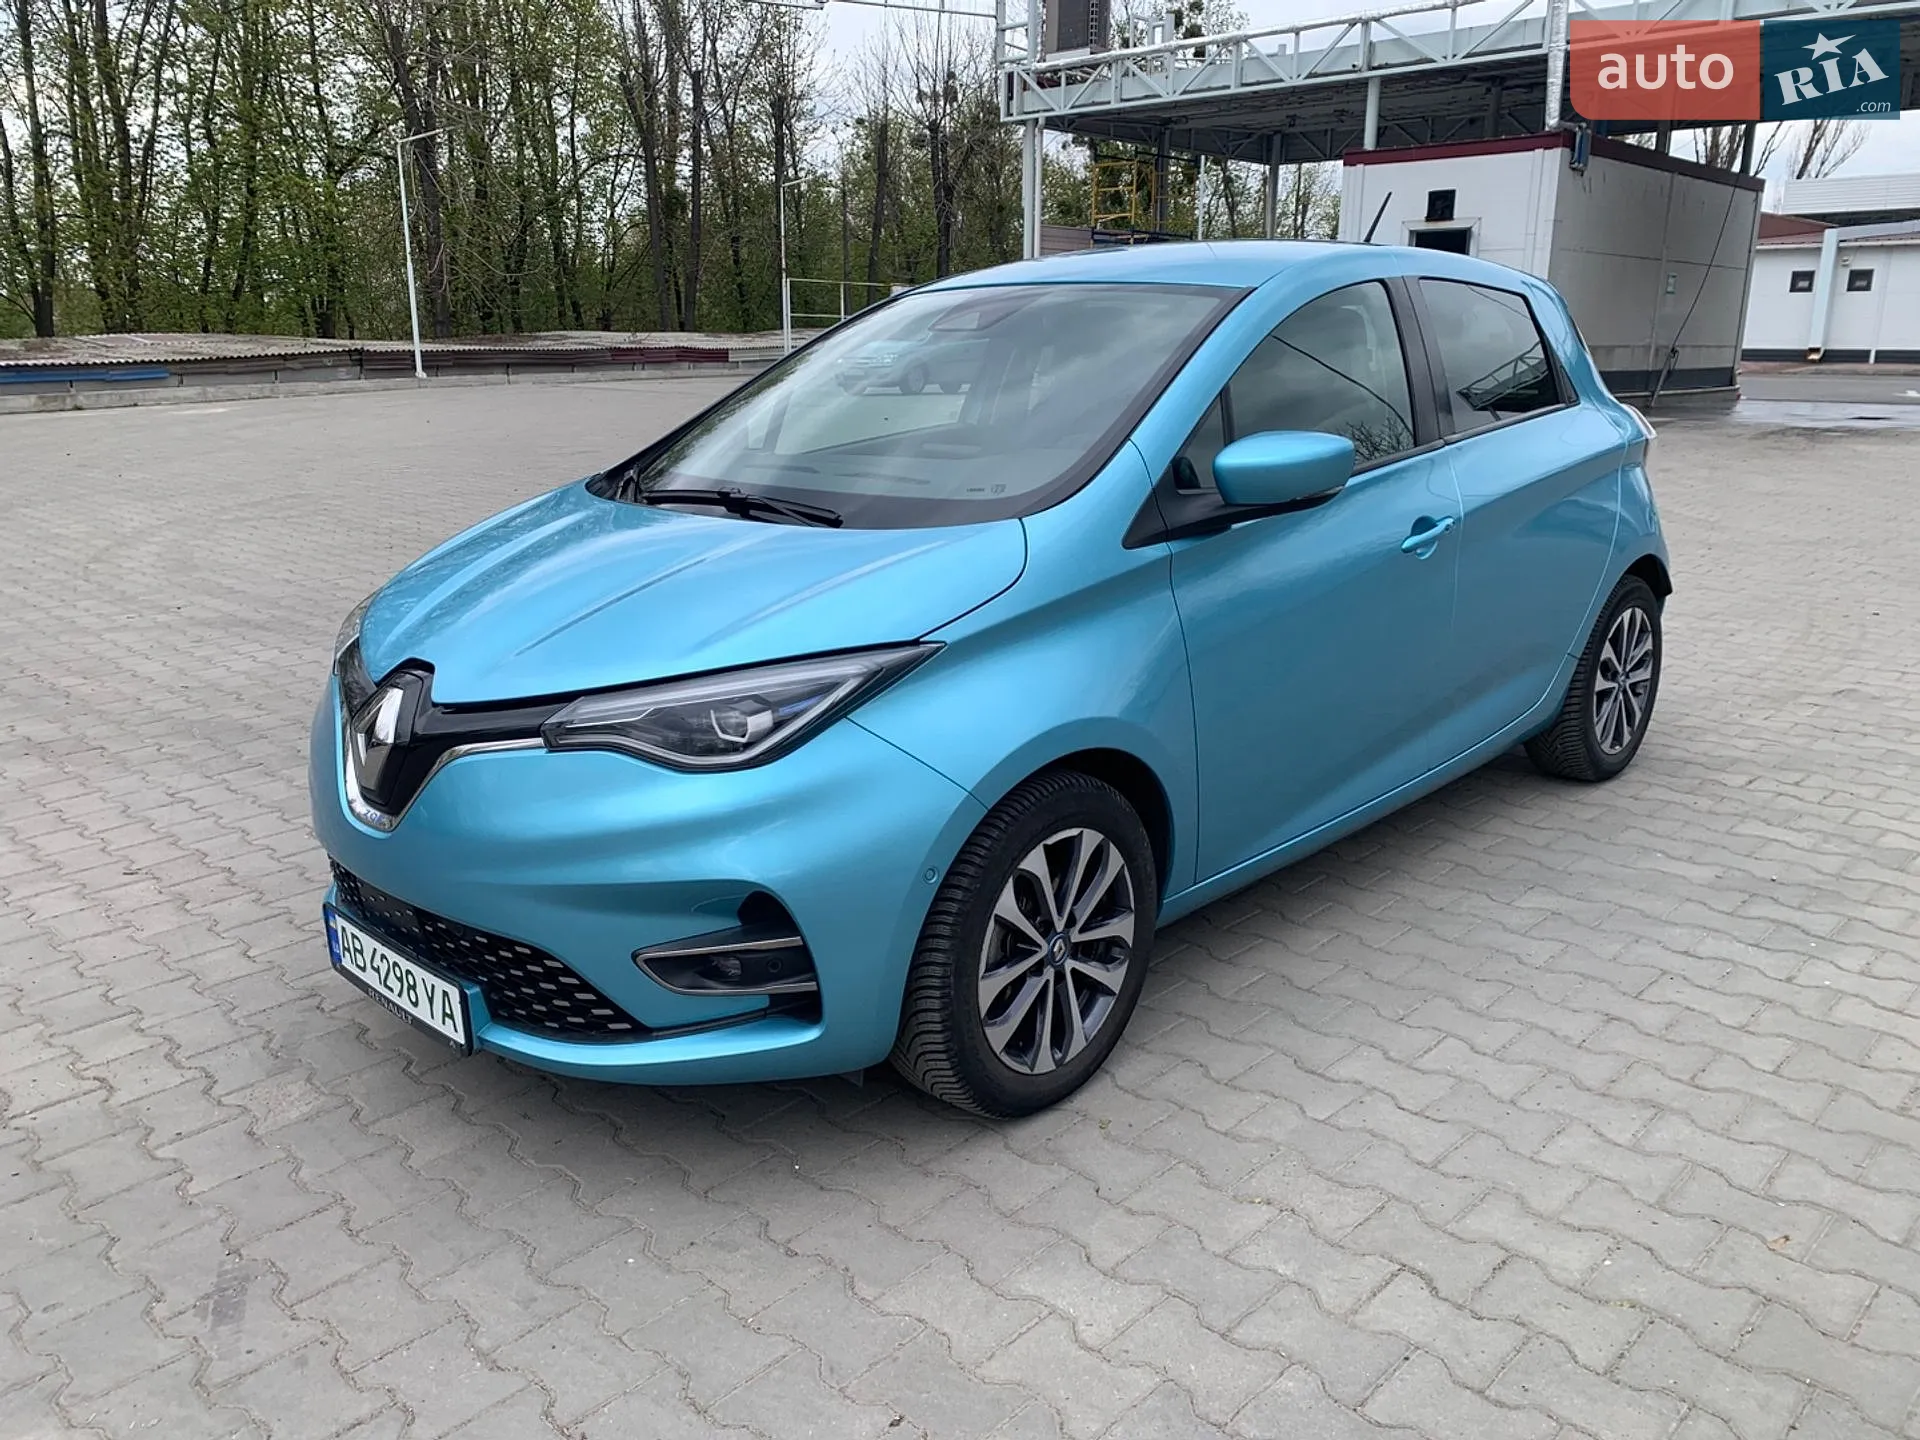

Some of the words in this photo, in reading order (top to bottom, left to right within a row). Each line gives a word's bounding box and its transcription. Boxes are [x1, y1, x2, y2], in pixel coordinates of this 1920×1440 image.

[341, 925, 367, 973] AB
[370, 948, 419, 1008] 4298
[422, 977, 458, 1033] YA
